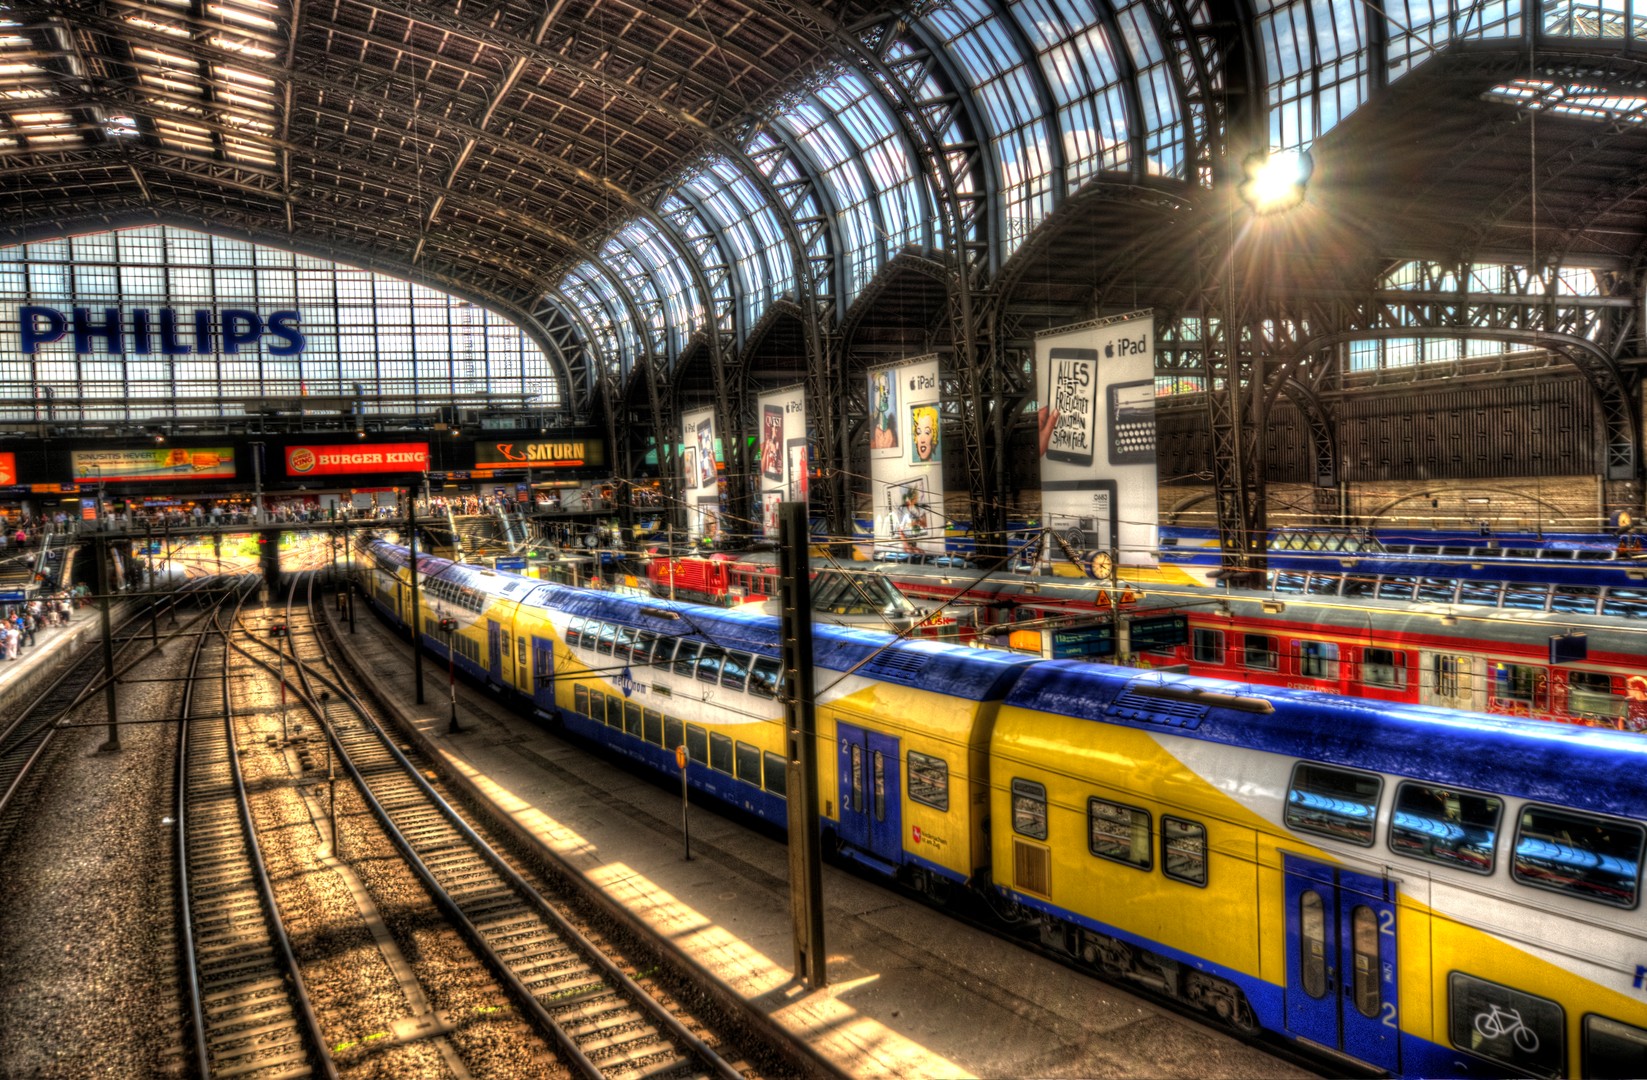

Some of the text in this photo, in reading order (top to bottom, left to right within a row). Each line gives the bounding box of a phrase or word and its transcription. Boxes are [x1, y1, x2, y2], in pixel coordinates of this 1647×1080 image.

[20, 306, 305, 356] PHILIPS
[1117, 334, 1147, 357] iPad
[917, 373, 935, 390] iPad
[1057, 360, 1090, 387] ALLES
[791, 399, 803, 413] iPad
[77, 452, 157, 461] SINUSITIS HEVERT
[319, 452, 425, 465] BURGER KING
[527, 442, 585, 460] SATURN
[294, 457, 312, 467] KING
[613, 675, 646, 694] metronom
[1538, 674, 1547, 689] 2
[841, 738, 849, 754] 2
[843, 794, 850, 811] 2
[1379, 909, 1395, 936] 2
[1381, 1001, 1398, 1029] 2
